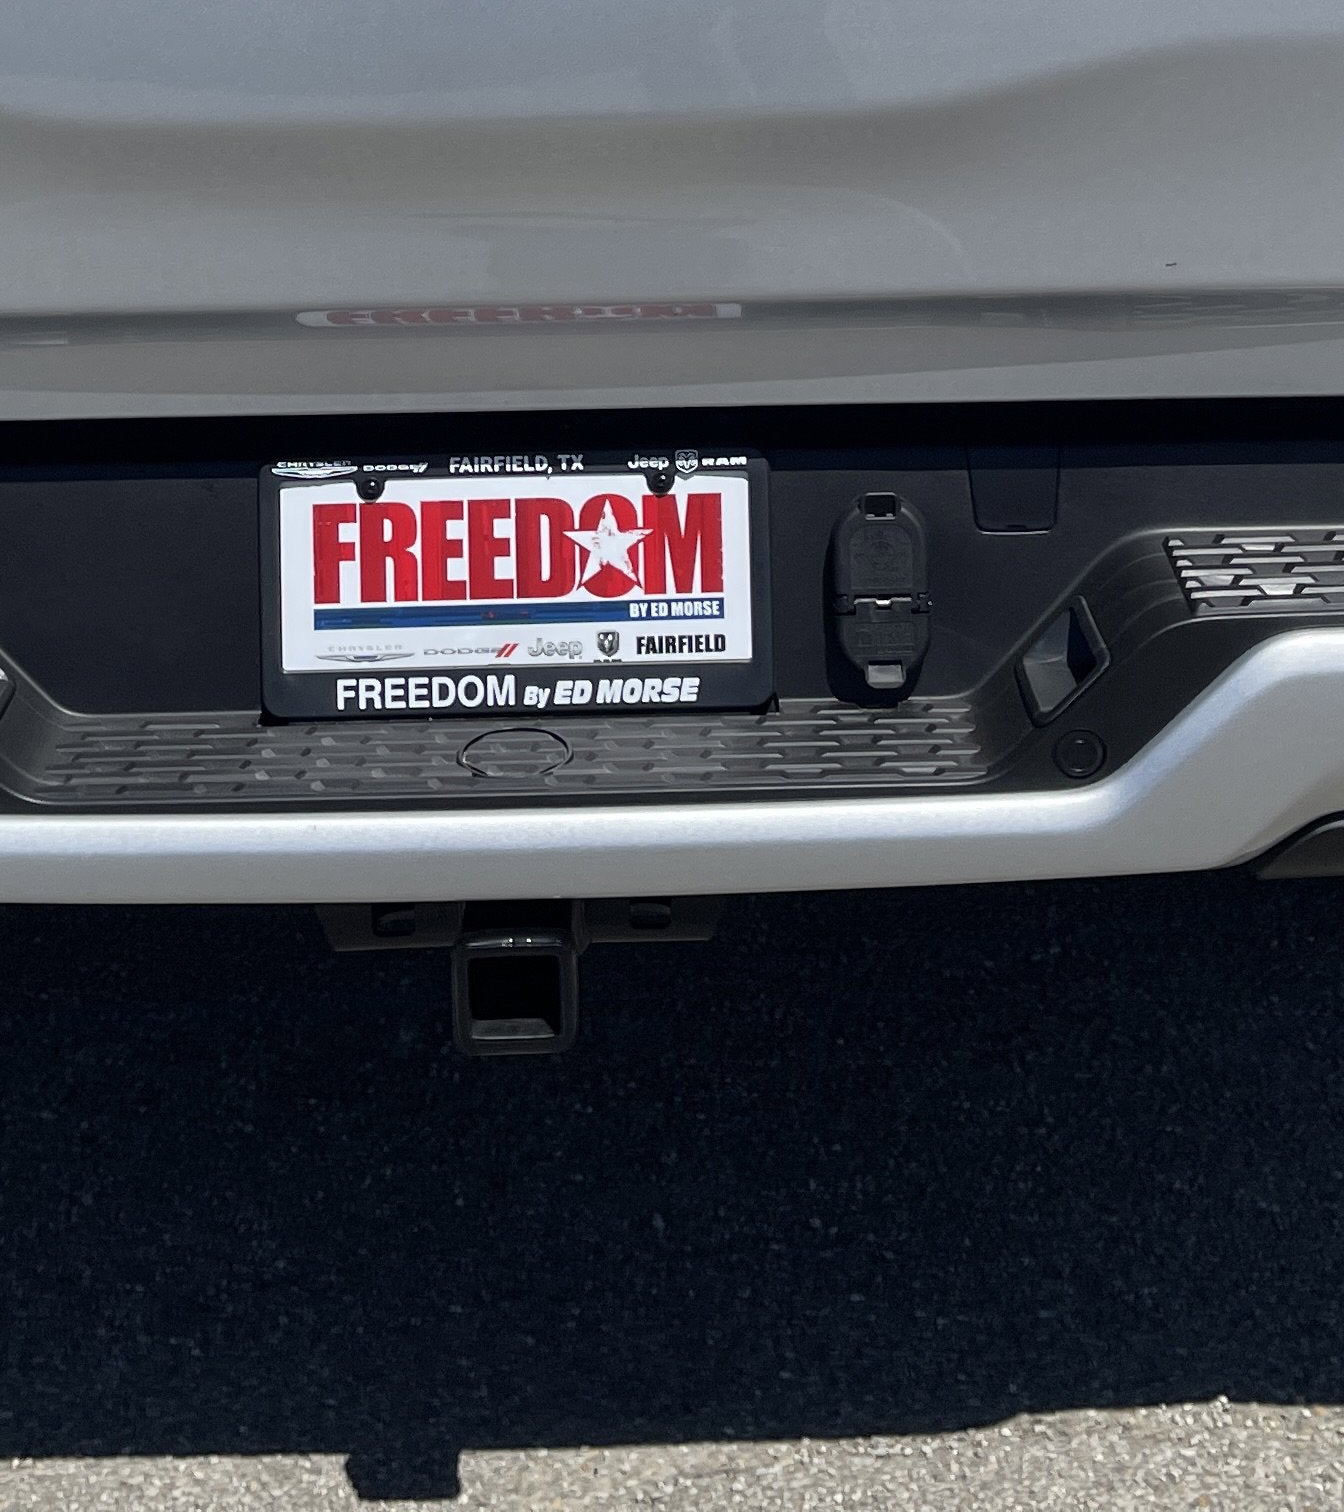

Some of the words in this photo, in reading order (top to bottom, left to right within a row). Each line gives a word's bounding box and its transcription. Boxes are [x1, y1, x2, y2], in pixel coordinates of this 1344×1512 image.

[449, 456, 552, 476] FAIRFIELD,
[557, 454, 584, 471] TX
[627, 454, 670, 470] Jeep
[701, 456, 748, 466] RAM
[312, 493, 724, 604] FREEDOM
[629, 602, 648, 618] BY
[651, 602, 669, 617] ED
[670, 600, 721, 617] MORSE
[527, 637, 583, 660] Jeep
[636, 634, 726, 655] FAIRFIELD
[335, 674, 516, 711] FREEDOM
[523, 686, 552, 709] By
[554, 681, 594, 706] ED
[596, 677, 701, 705] MORSE
